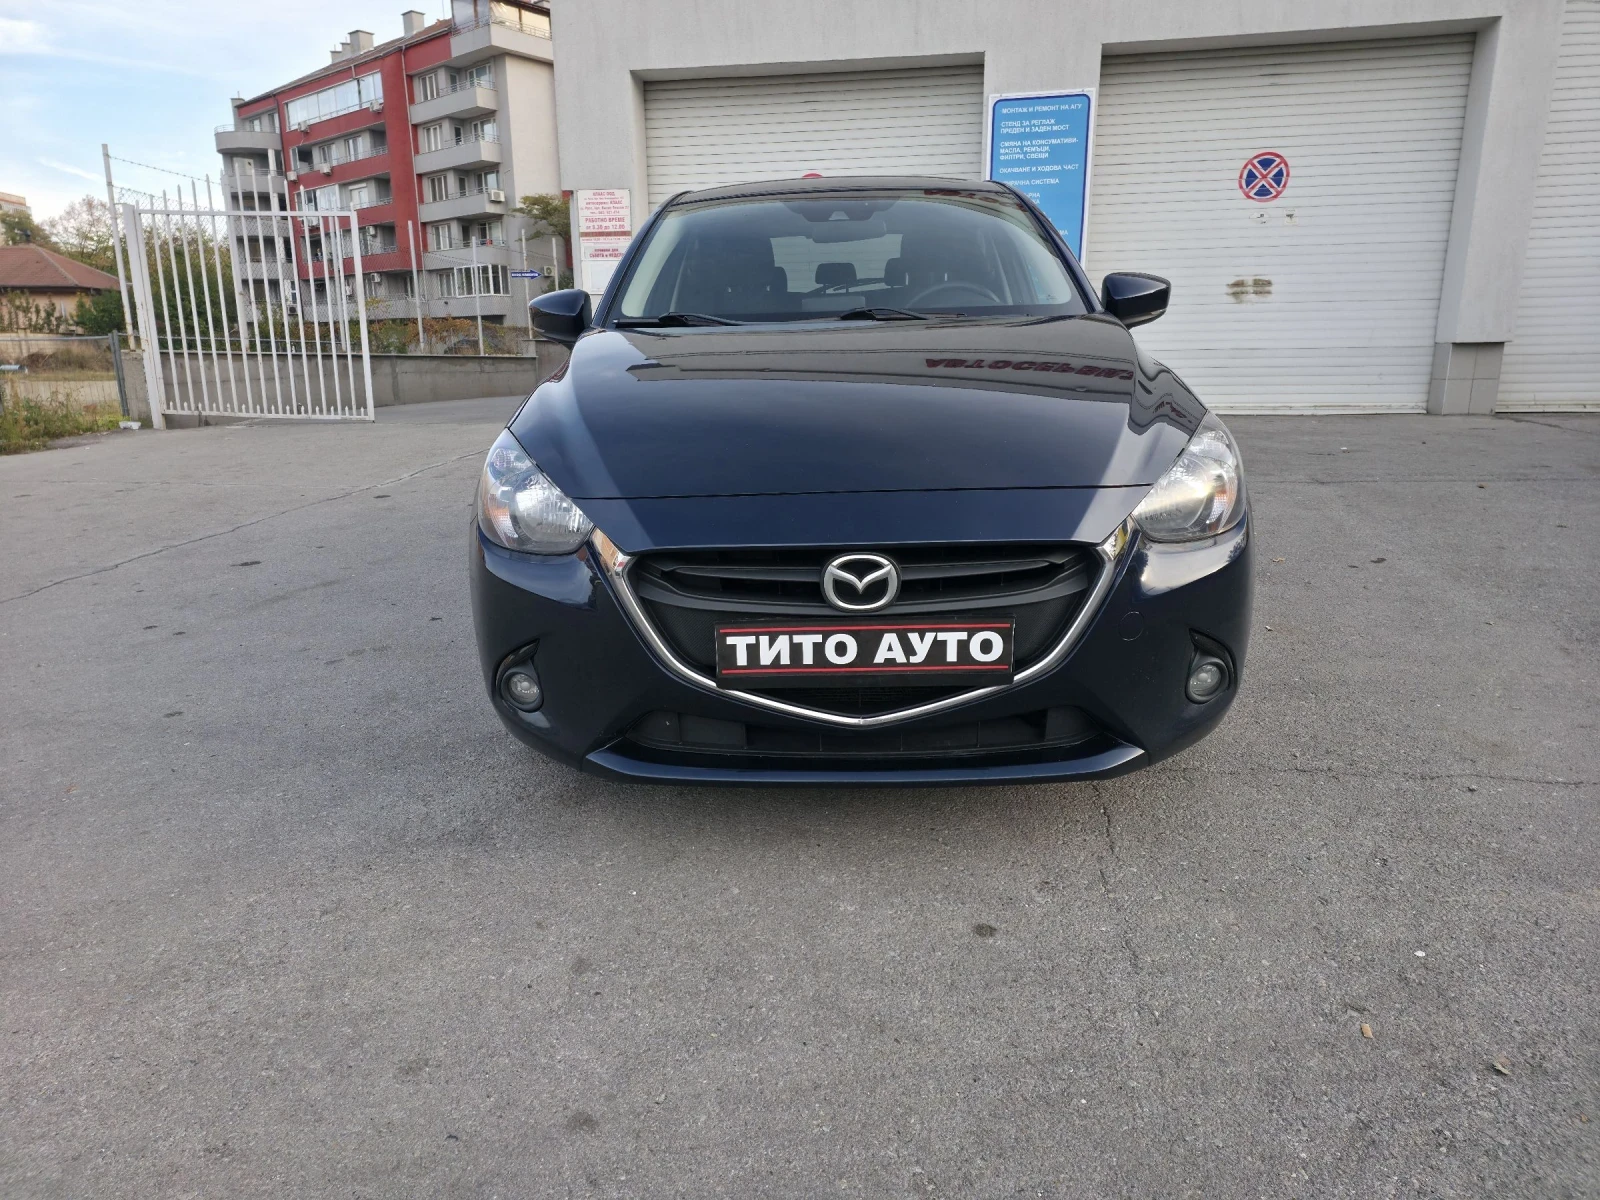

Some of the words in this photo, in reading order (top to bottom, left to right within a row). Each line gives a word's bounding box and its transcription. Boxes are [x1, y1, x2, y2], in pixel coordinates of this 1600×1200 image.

[1001, 106, 1028, 114] МОНТАЖ
[1034, 104, 1059, 112] РЕМОНТ
[1031, 118, 1056, 126] РЕГЛАЖ
[1000, 126, 1025, 134] ПРЕДЕН
[1031, 125, 1052, 133] ЗАДЕН
[999, 166, 1031, 174] ОКАЧВАНЕ
[726, 633, 858, 666] ТИТО
[873, 630, 1004, 664] АУТО
